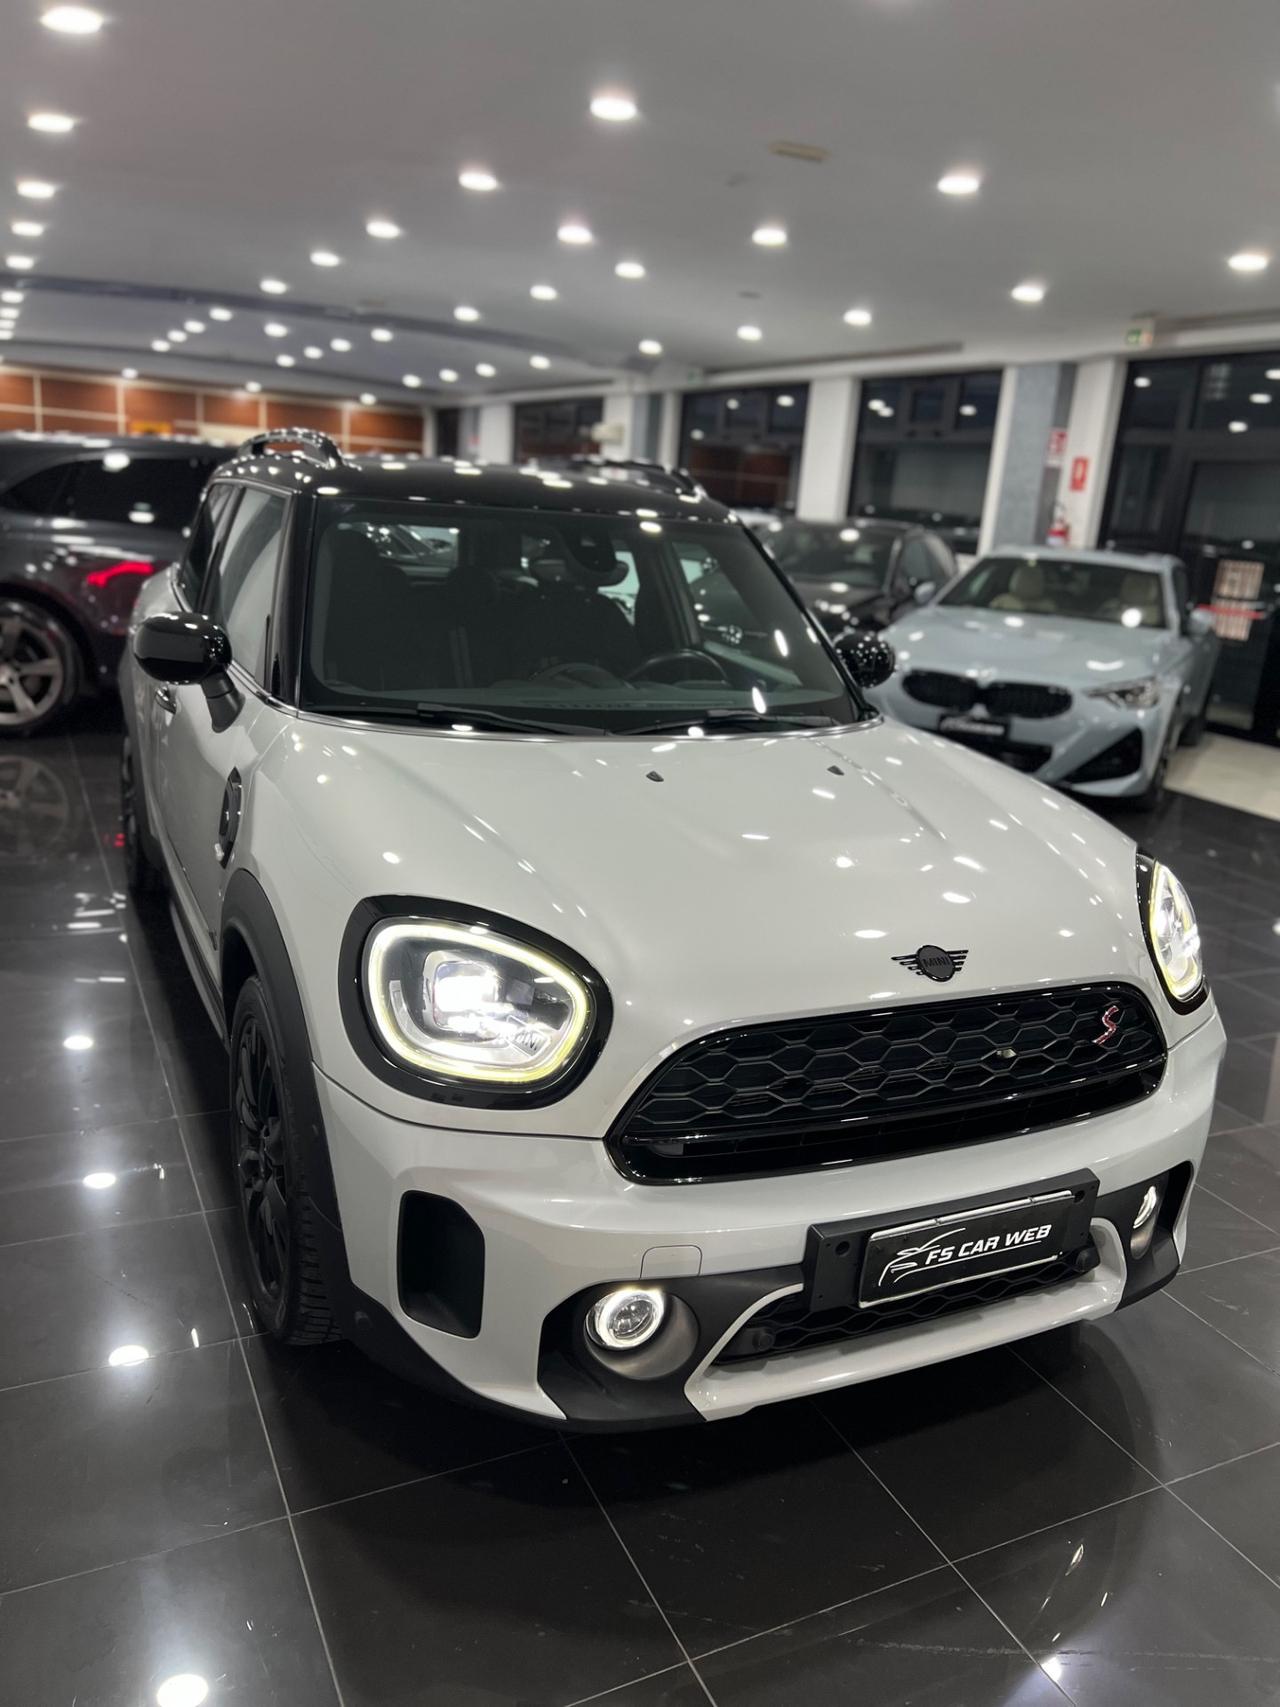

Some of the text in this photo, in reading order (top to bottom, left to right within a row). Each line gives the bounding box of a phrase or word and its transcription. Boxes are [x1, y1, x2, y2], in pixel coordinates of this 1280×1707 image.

[922, 956, 950, 967] MINI
[1092, 1005, 1119, 1046] S
[925, 1224, 1052, 1265] FS CAR WEB
